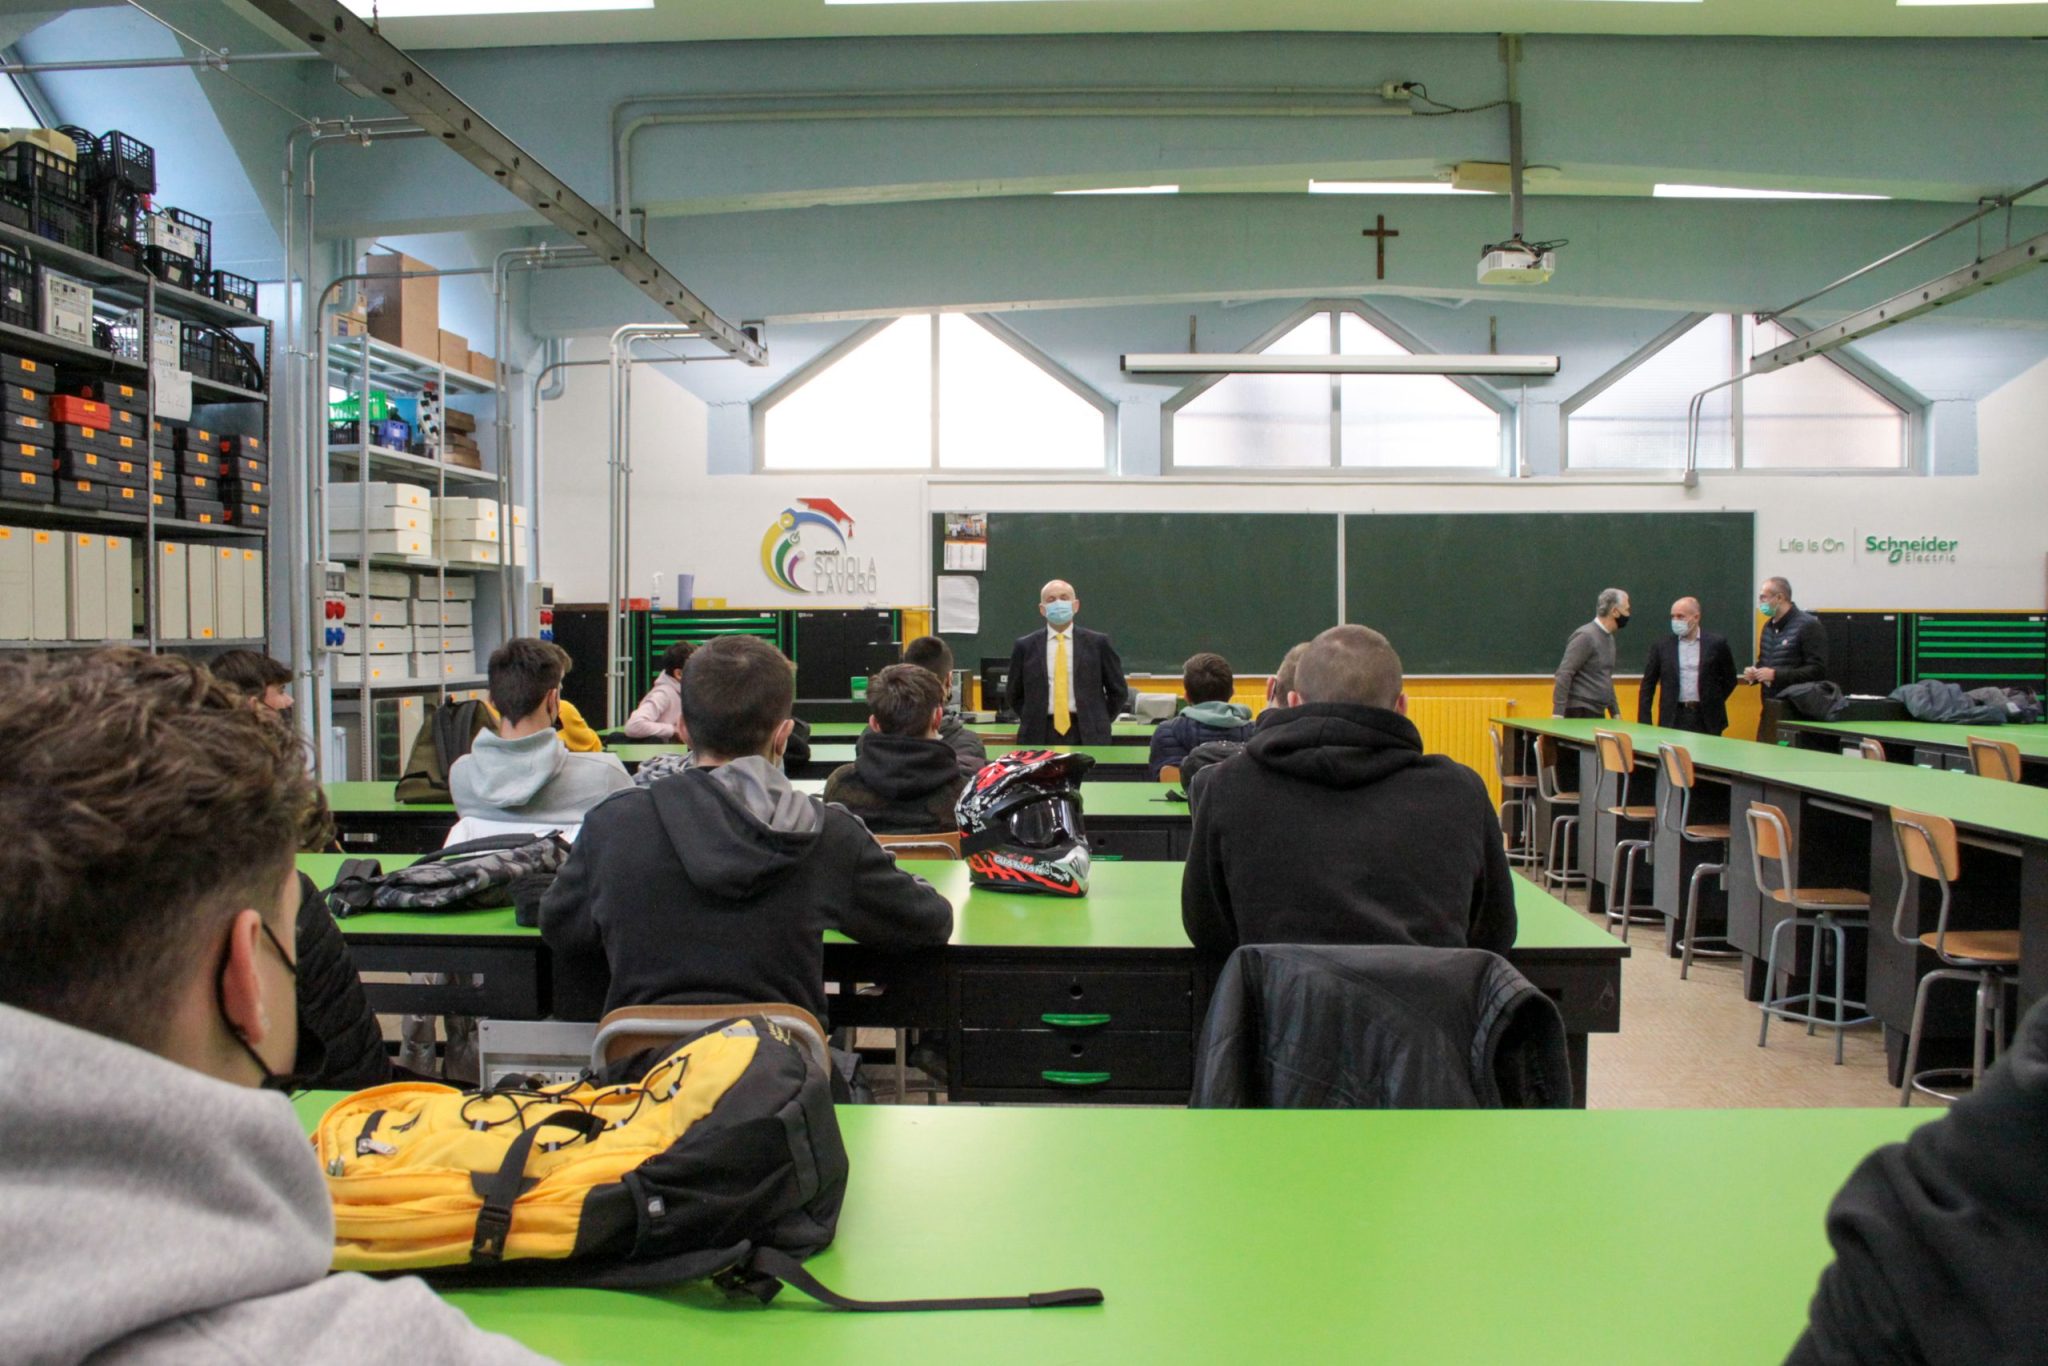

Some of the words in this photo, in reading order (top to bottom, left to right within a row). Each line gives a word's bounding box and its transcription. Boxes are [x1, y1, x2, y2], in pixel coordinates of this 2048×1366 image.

[1779, 538, 1804, 552] Life
[1865, 535, 1958, 552] Schneider
[814, 557, 876, 575] SCUOLA
[1904, 552, 1956, 563] Electric
[815, 574, 877, 594] LAVORO
